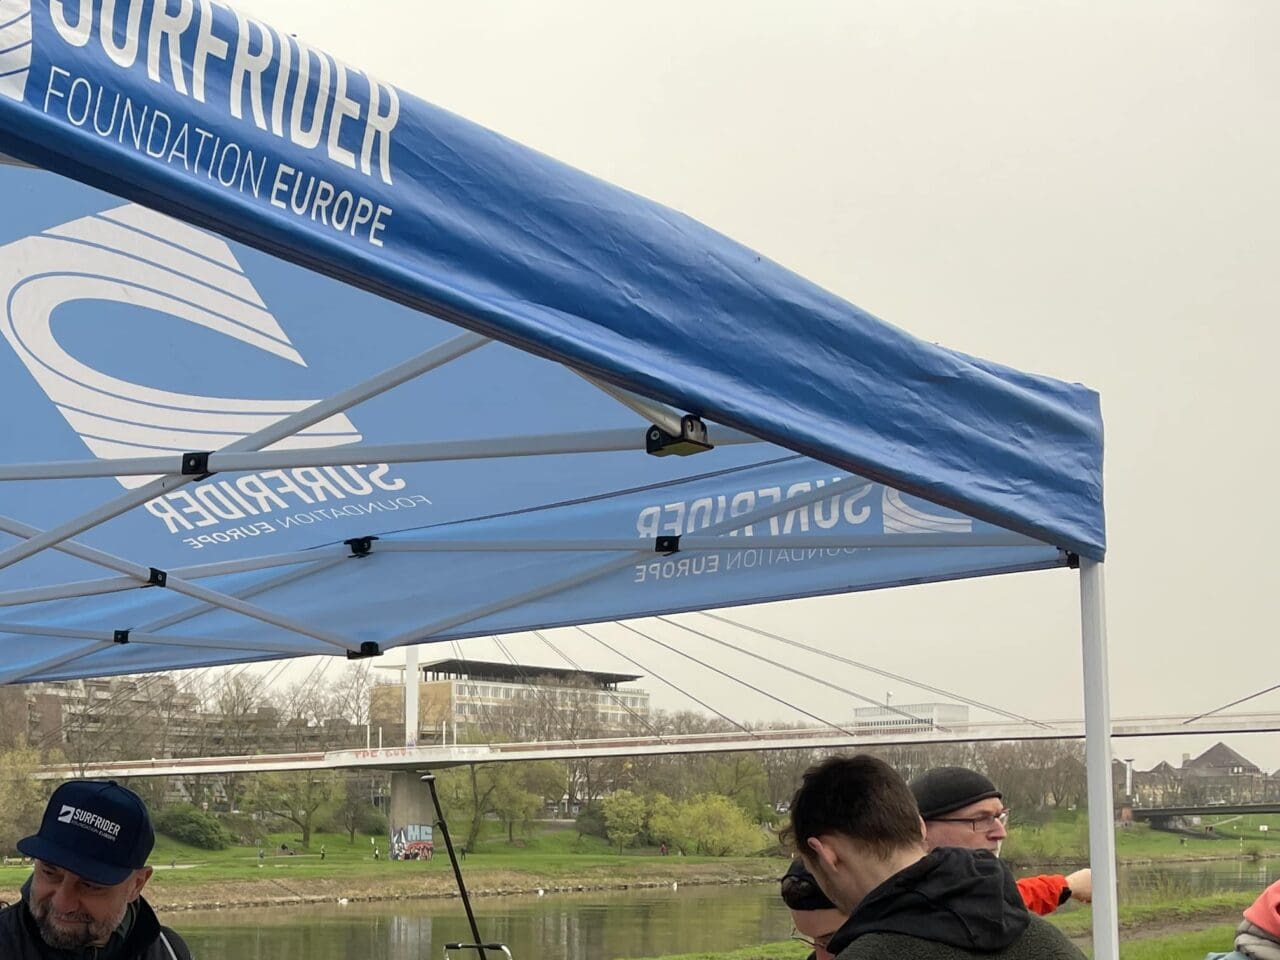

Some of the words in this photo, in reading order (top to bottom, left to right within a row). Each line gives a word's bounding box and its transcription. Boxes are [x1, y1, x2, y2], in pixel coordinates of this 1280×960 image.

[43, 65, 268, 199] FOUNDATION
[271, 164, 393, 247] EUROPE
[73, 808, 121, 836] SURFRIDER
